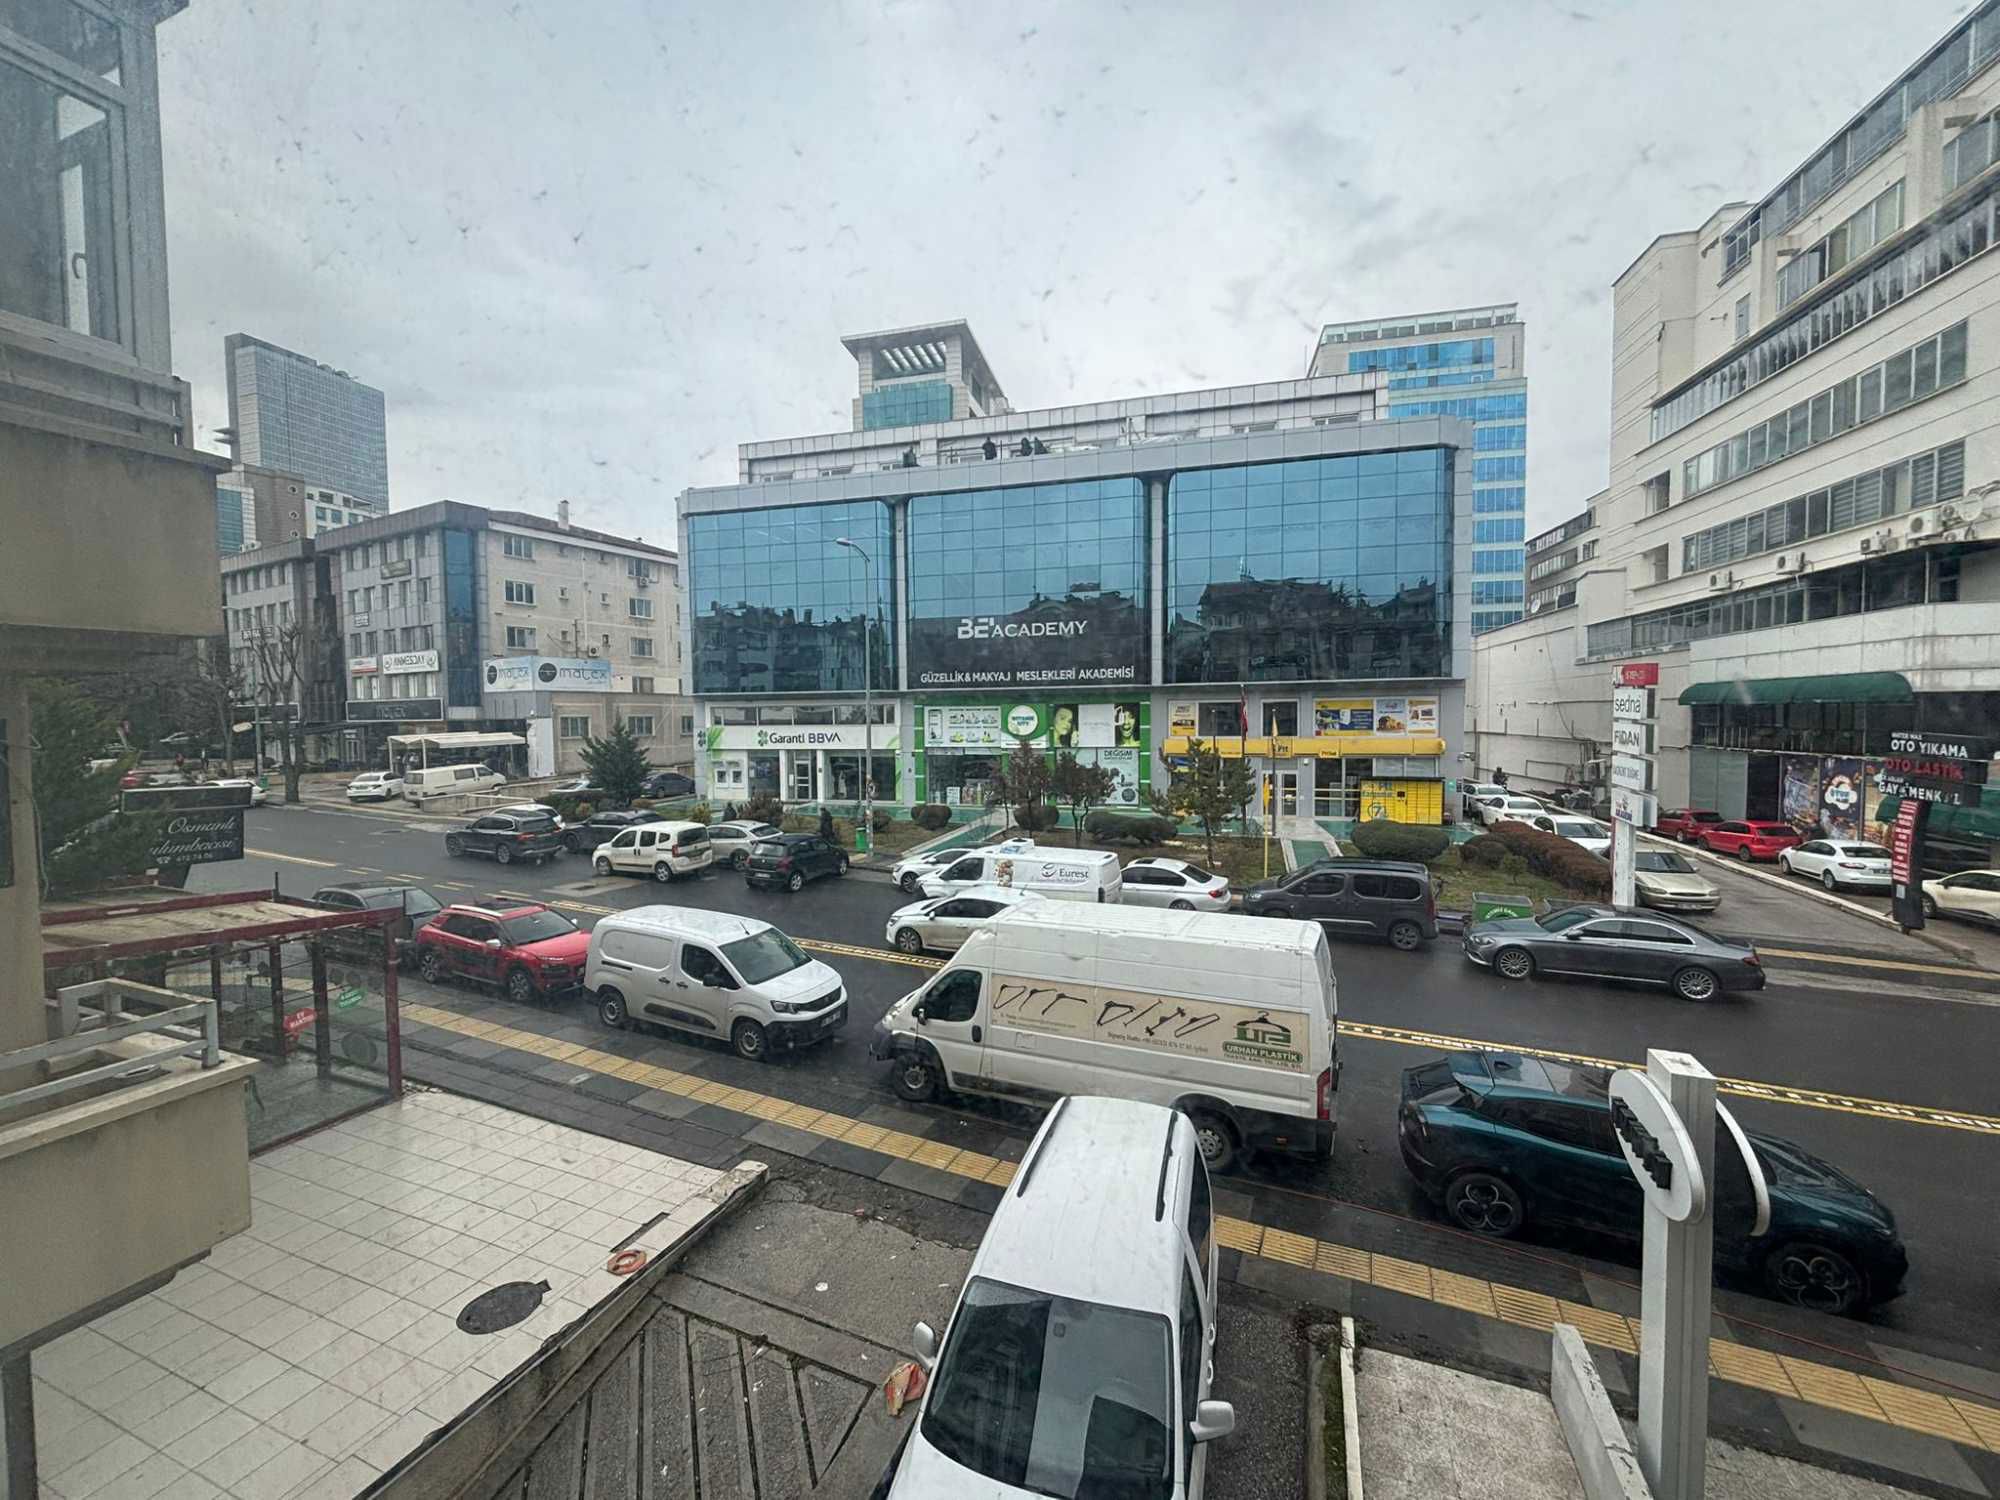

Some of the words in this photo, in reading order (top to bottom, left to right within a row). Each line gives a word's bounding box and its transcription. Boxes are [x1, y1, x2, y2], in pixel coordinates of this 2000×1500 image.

[991, 620, 1088, 638] ACADEMY
[1078, 665, 1135, 680] AKADEMİSİ
[769, 732, 805, 744] Garanti
[808, 732, 842, 744] BBVA
[1891, 740, 1916, 752] OTO
[1919, 741, 1968, 759] YIKAMA
[1886, 758, 1912, 772] OTO
